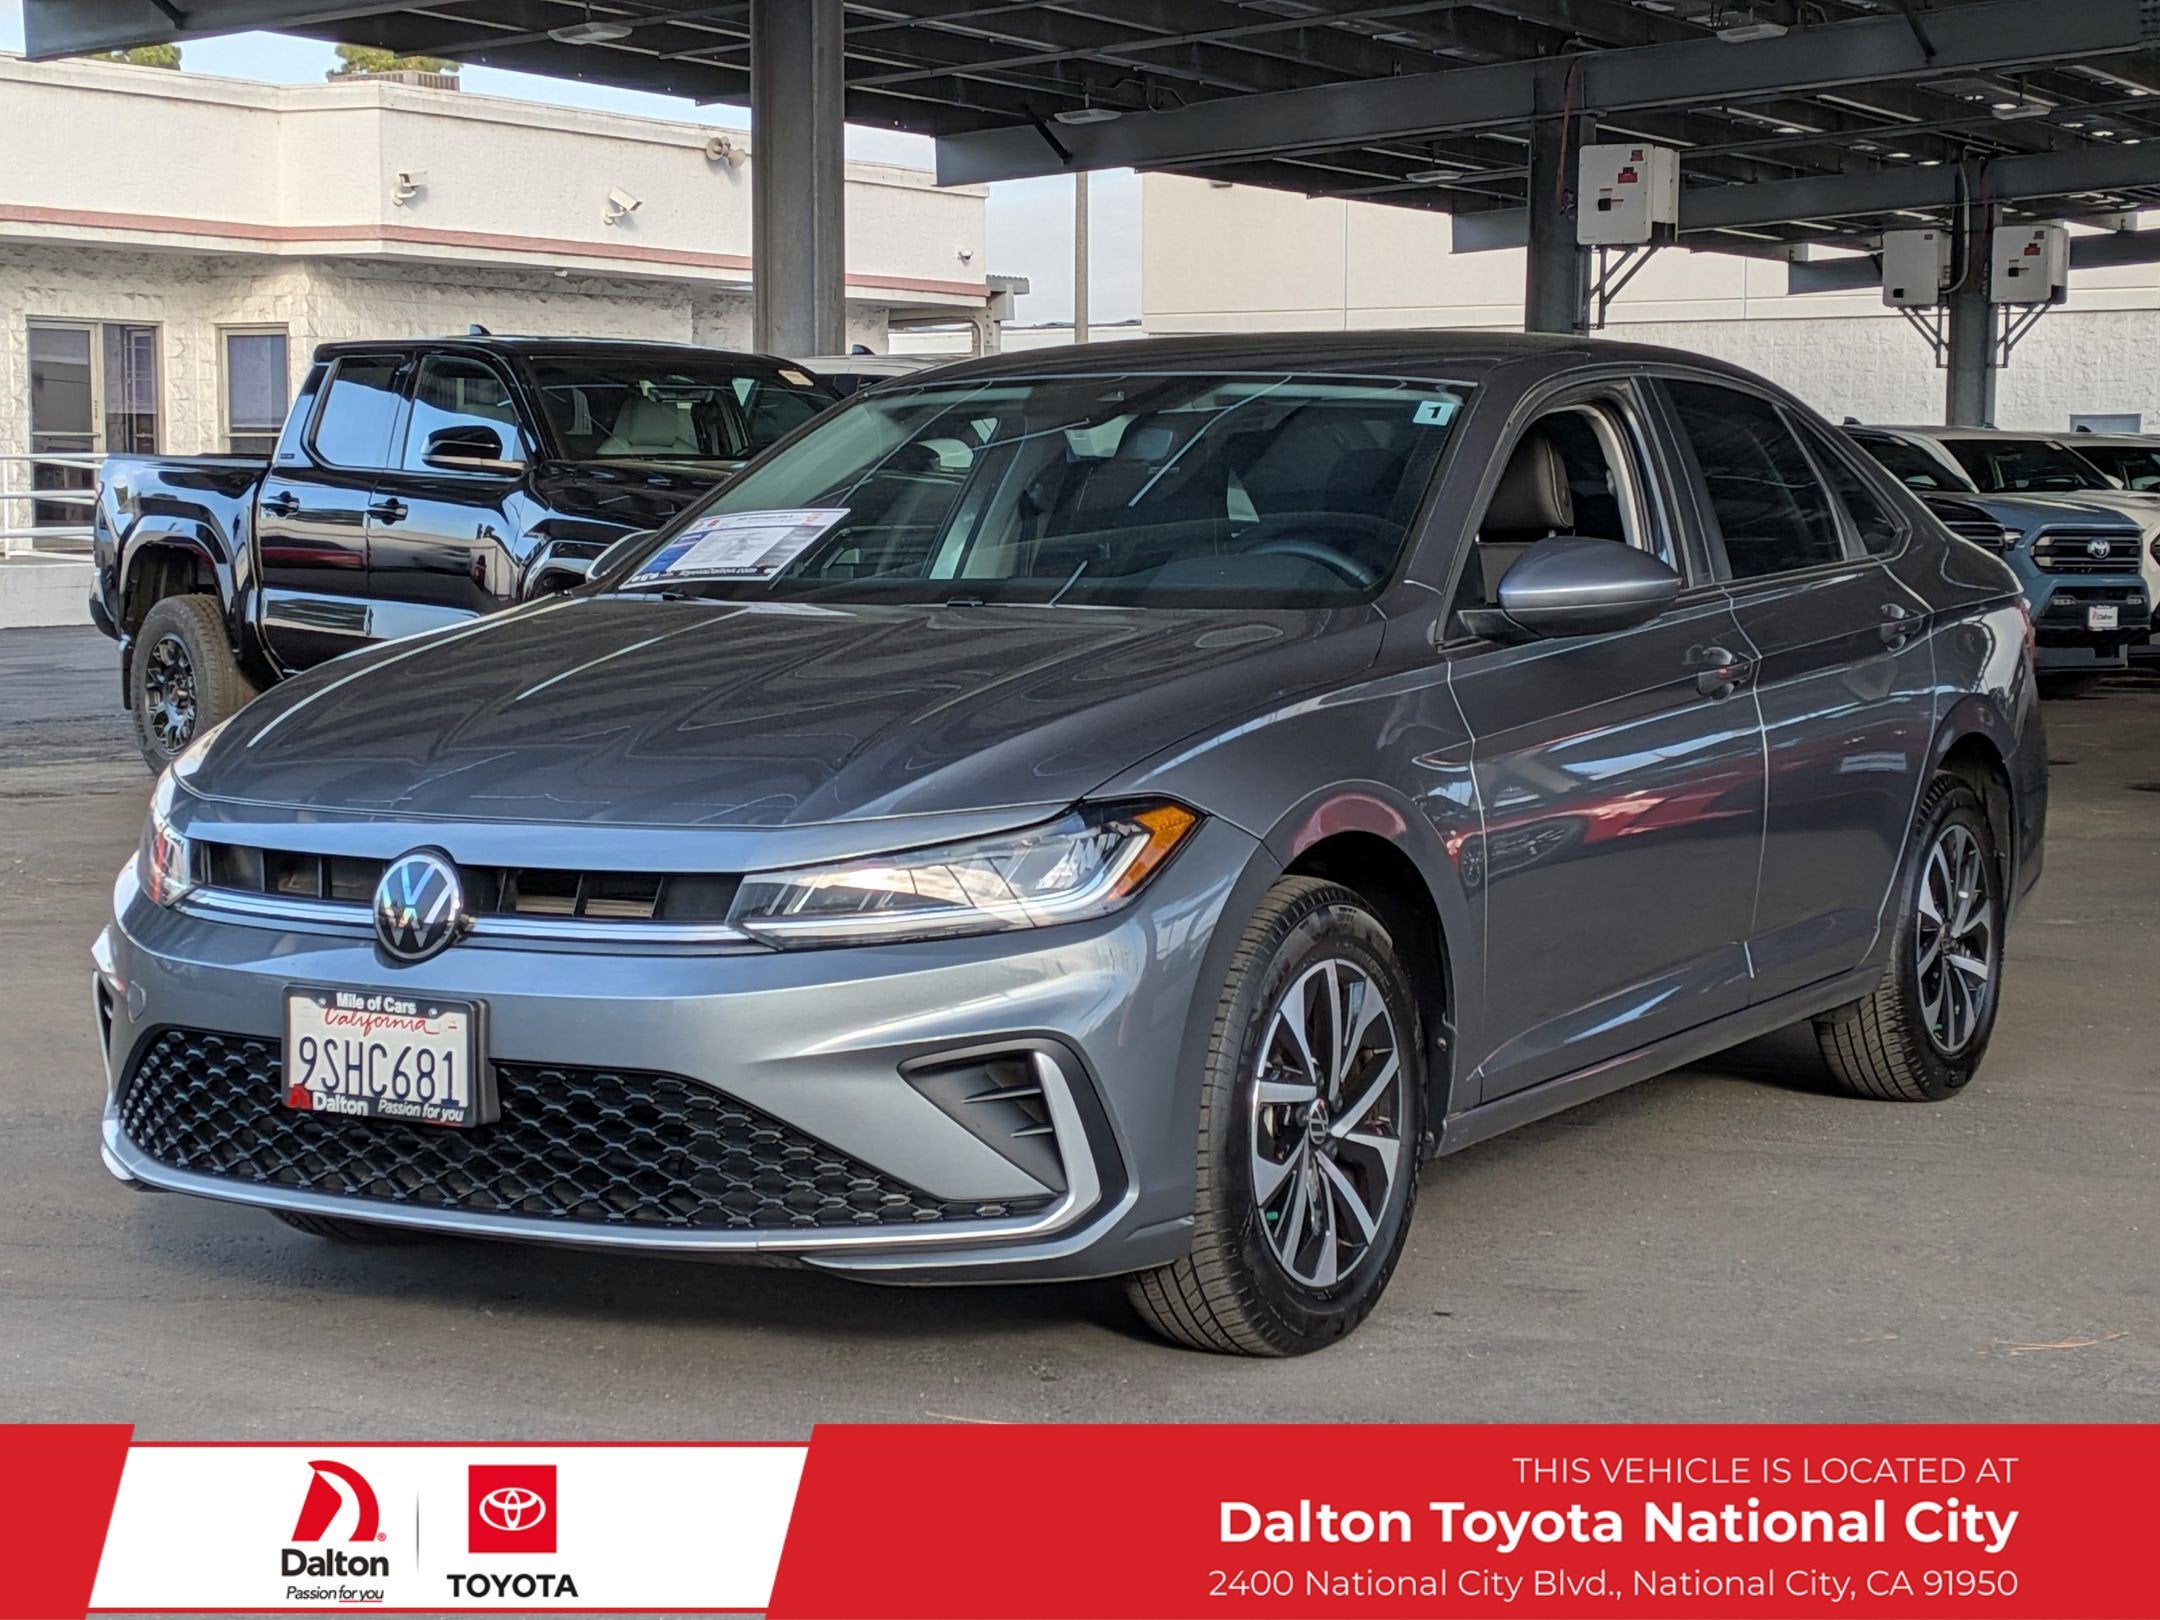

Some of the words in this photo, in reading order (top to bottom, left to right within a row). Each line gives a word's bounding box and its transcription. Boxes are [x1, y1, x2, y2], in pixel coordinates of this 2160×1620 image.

[1427, 405, 1443, 419] 1
[336, 991, 364, 1010] Mile
[366, 995, 382, 1011] of
[383, 997, 417, 1015] Cars
[324, 1007, 440, 1037] California
[299, 1036, 459, 1107] 9SHC681
[312, 1091, 368, 1116] Dalton
[377, 1099, 421, 1117] Passion
[422, 1102, 443, 1119] for
[441, 1107, 464, 1122] you
